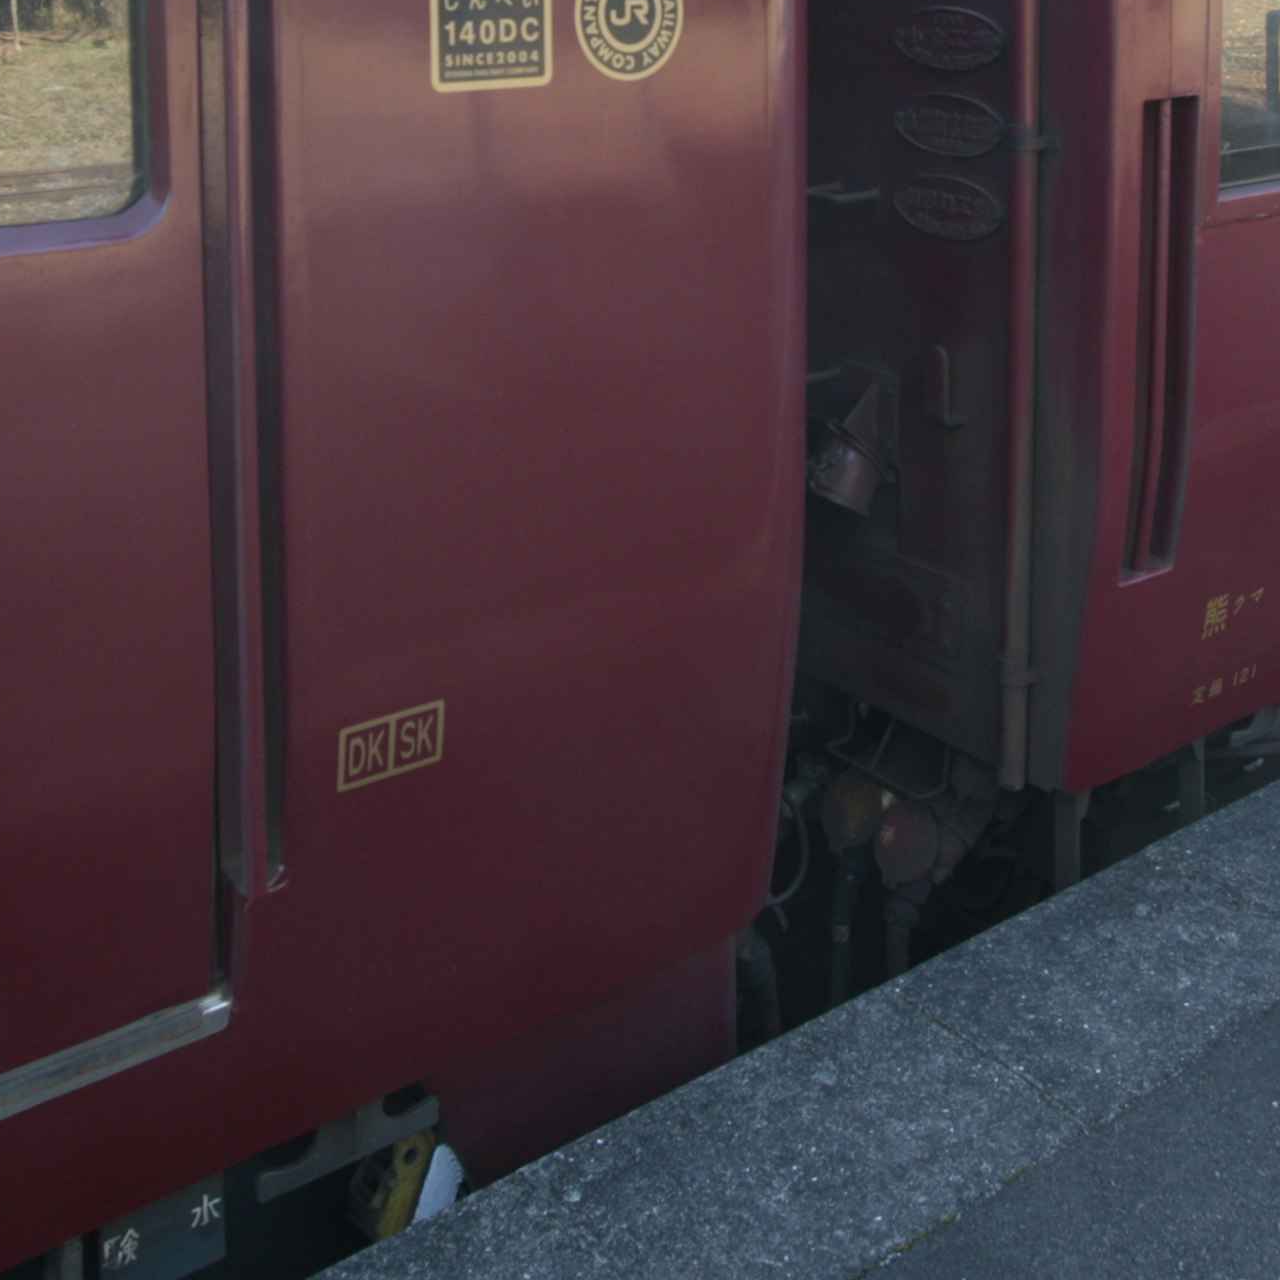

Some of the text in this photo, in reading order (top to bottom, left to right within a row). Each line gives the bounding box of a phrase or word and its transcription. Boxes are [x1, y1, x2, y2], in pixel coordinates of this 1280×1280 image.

[444, 16, 540, 46] 140DC
[348, 714, 434, 777] DK SK
